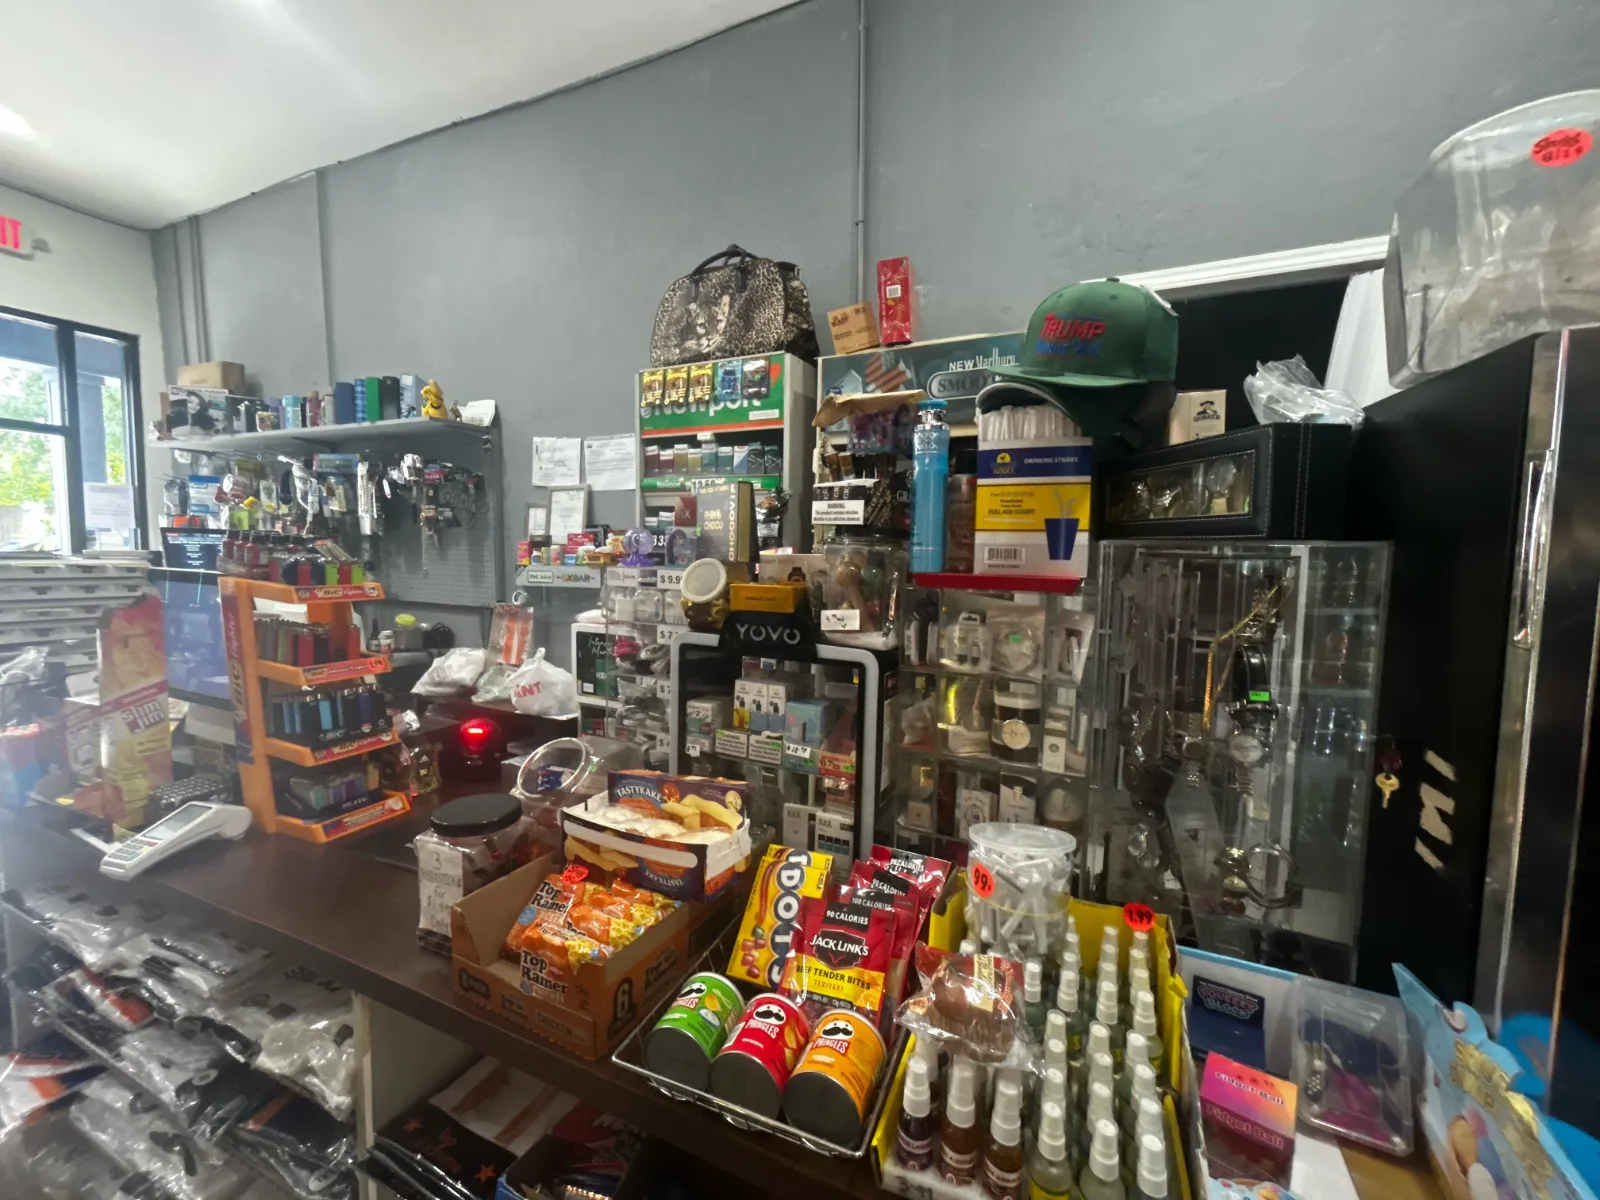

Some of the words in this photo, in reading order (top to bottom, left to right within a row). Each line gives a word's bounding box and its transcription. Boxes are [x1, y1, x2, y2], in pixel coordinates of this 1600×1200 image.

[1040, 313, 1106, 341] TRUMP
[949, 359, 975, 372] NEW
[616, 785, 663, 803] TASTYKAKE
[538, 880, 562, 899] Top
[826, 909, 834, 918] 90
[835, 911, 869, 926] CALORIES
[1126, 908, 1153, 924] 1.99
[809, 934, 837, 951] JACK
[521, 948, 549, 974] Top
[813, 967, 845, 982] TENDER
[847, 975, 872, 991] BITES
[745, 1018, 780, 1039] PRINGLES
[813, 1037, 849, 1054] PRINGLES
[1215, 1071, 1256, 1094] Fidget
[1258, 1089, 1285, 1106] Ball
[1206, 1102, 1252, 1133] Fidget
[1252, 1124, 1284, 1150] Ball
